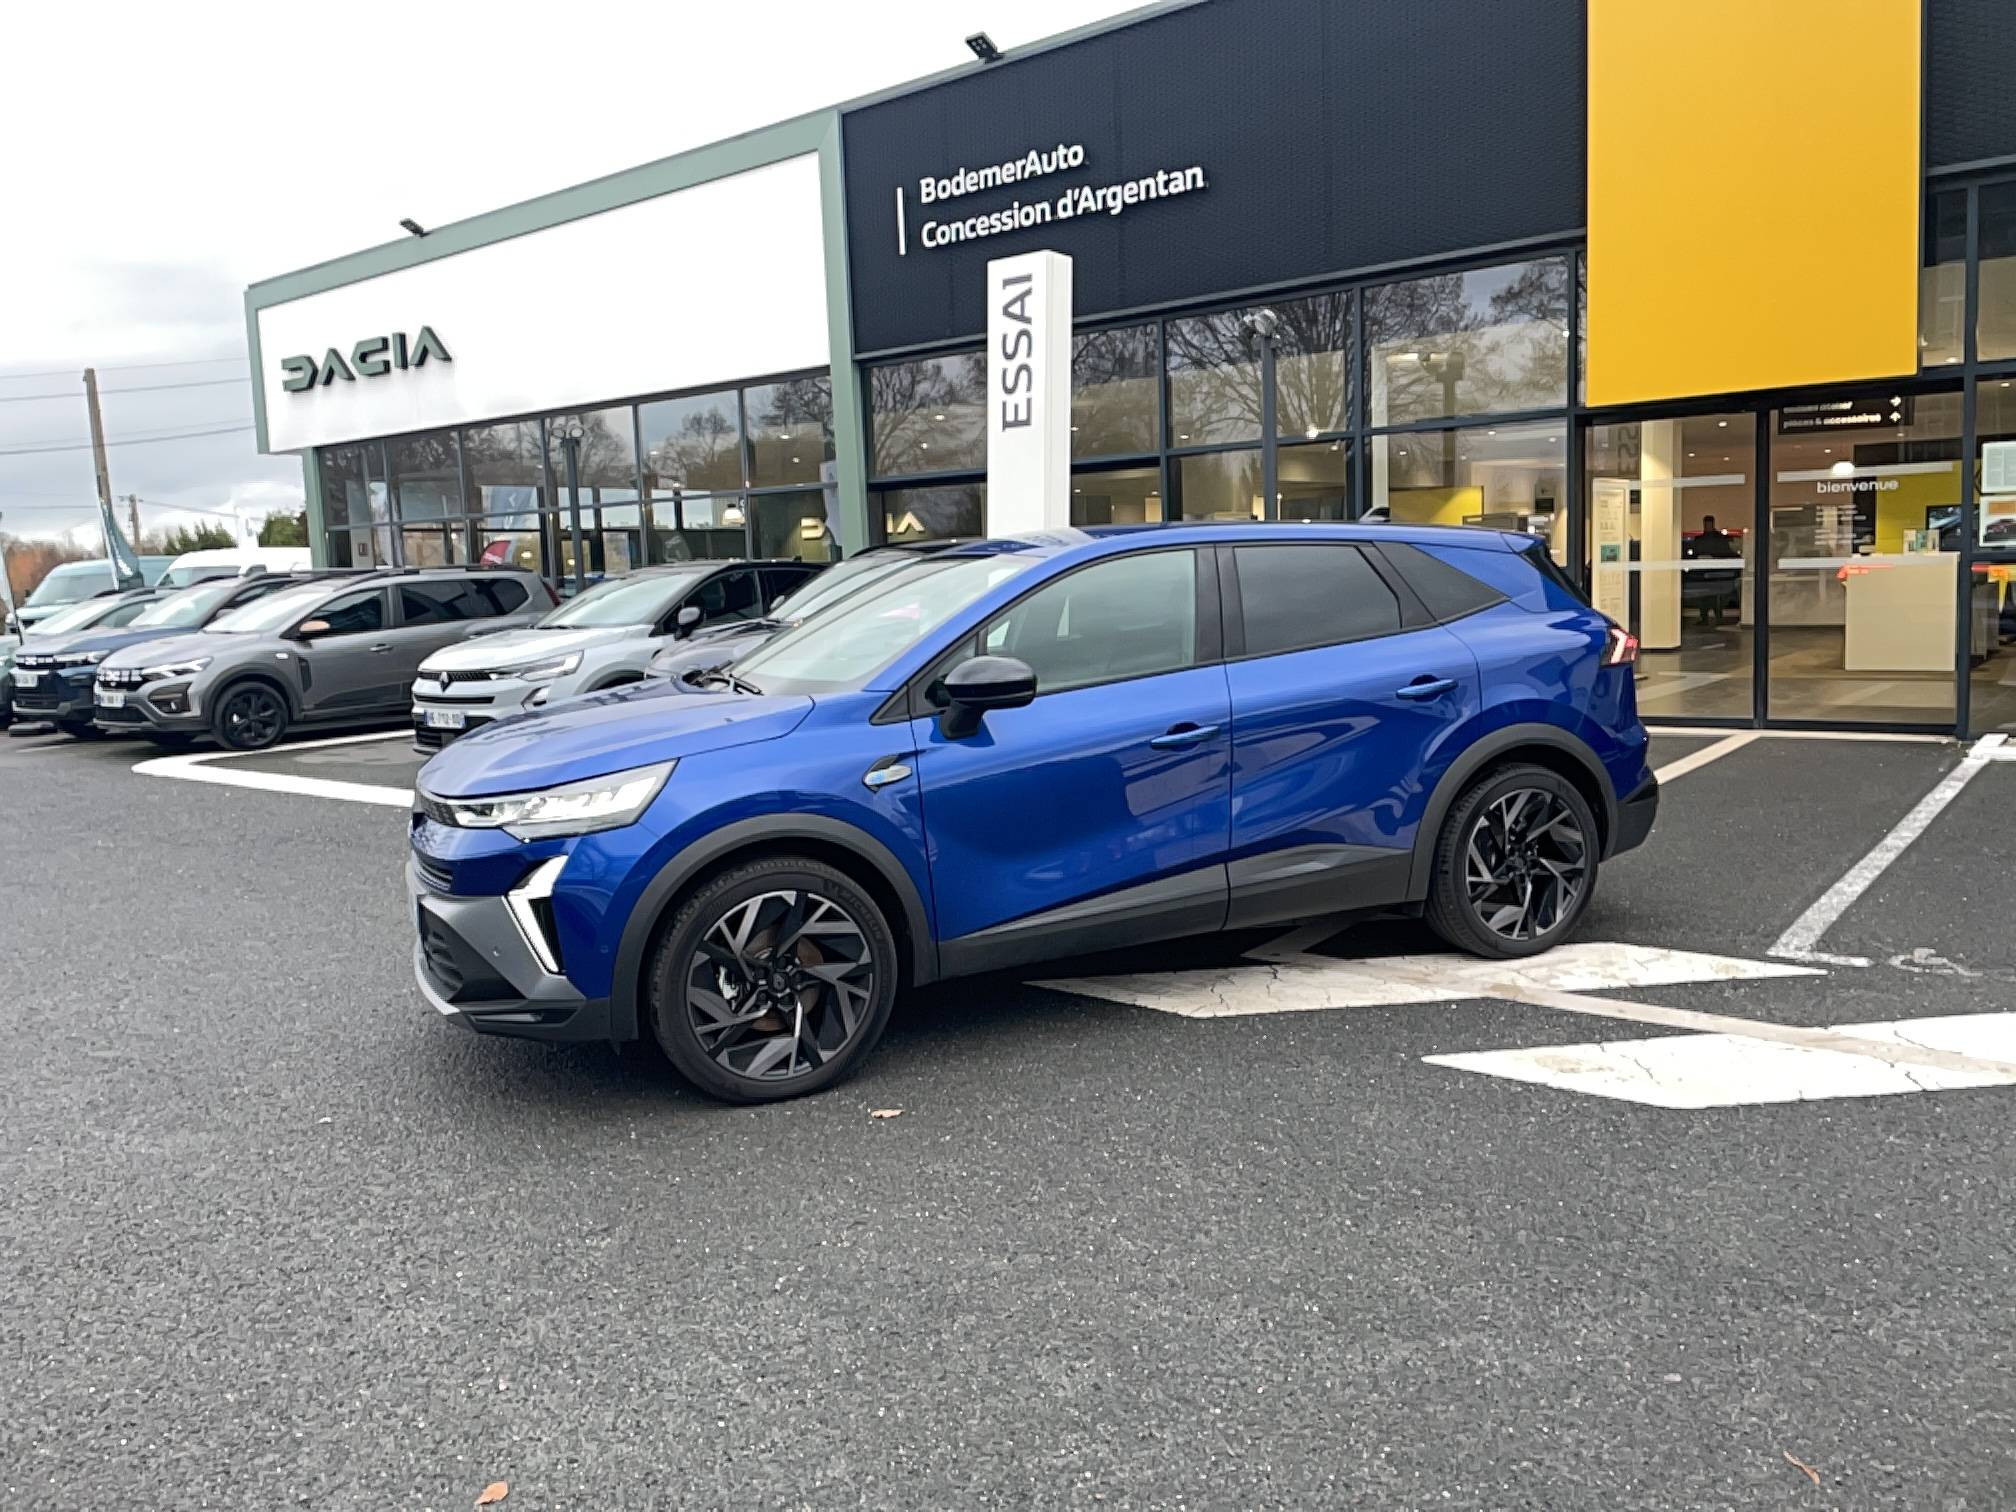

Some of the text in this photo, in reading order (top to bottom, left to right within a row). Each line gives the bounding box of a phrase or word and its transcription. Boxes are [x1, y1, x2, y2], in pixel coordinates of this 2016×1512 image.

[919, 144, 1084, 204] BodemerAuto
[921, 166, 1204, 248] Concession d'Argentan
[281, 325, 452, 392] DACIA
[1002, 273, 1033, 432] ESSAI
[1816, 480, 1899, 494] bienvenue
